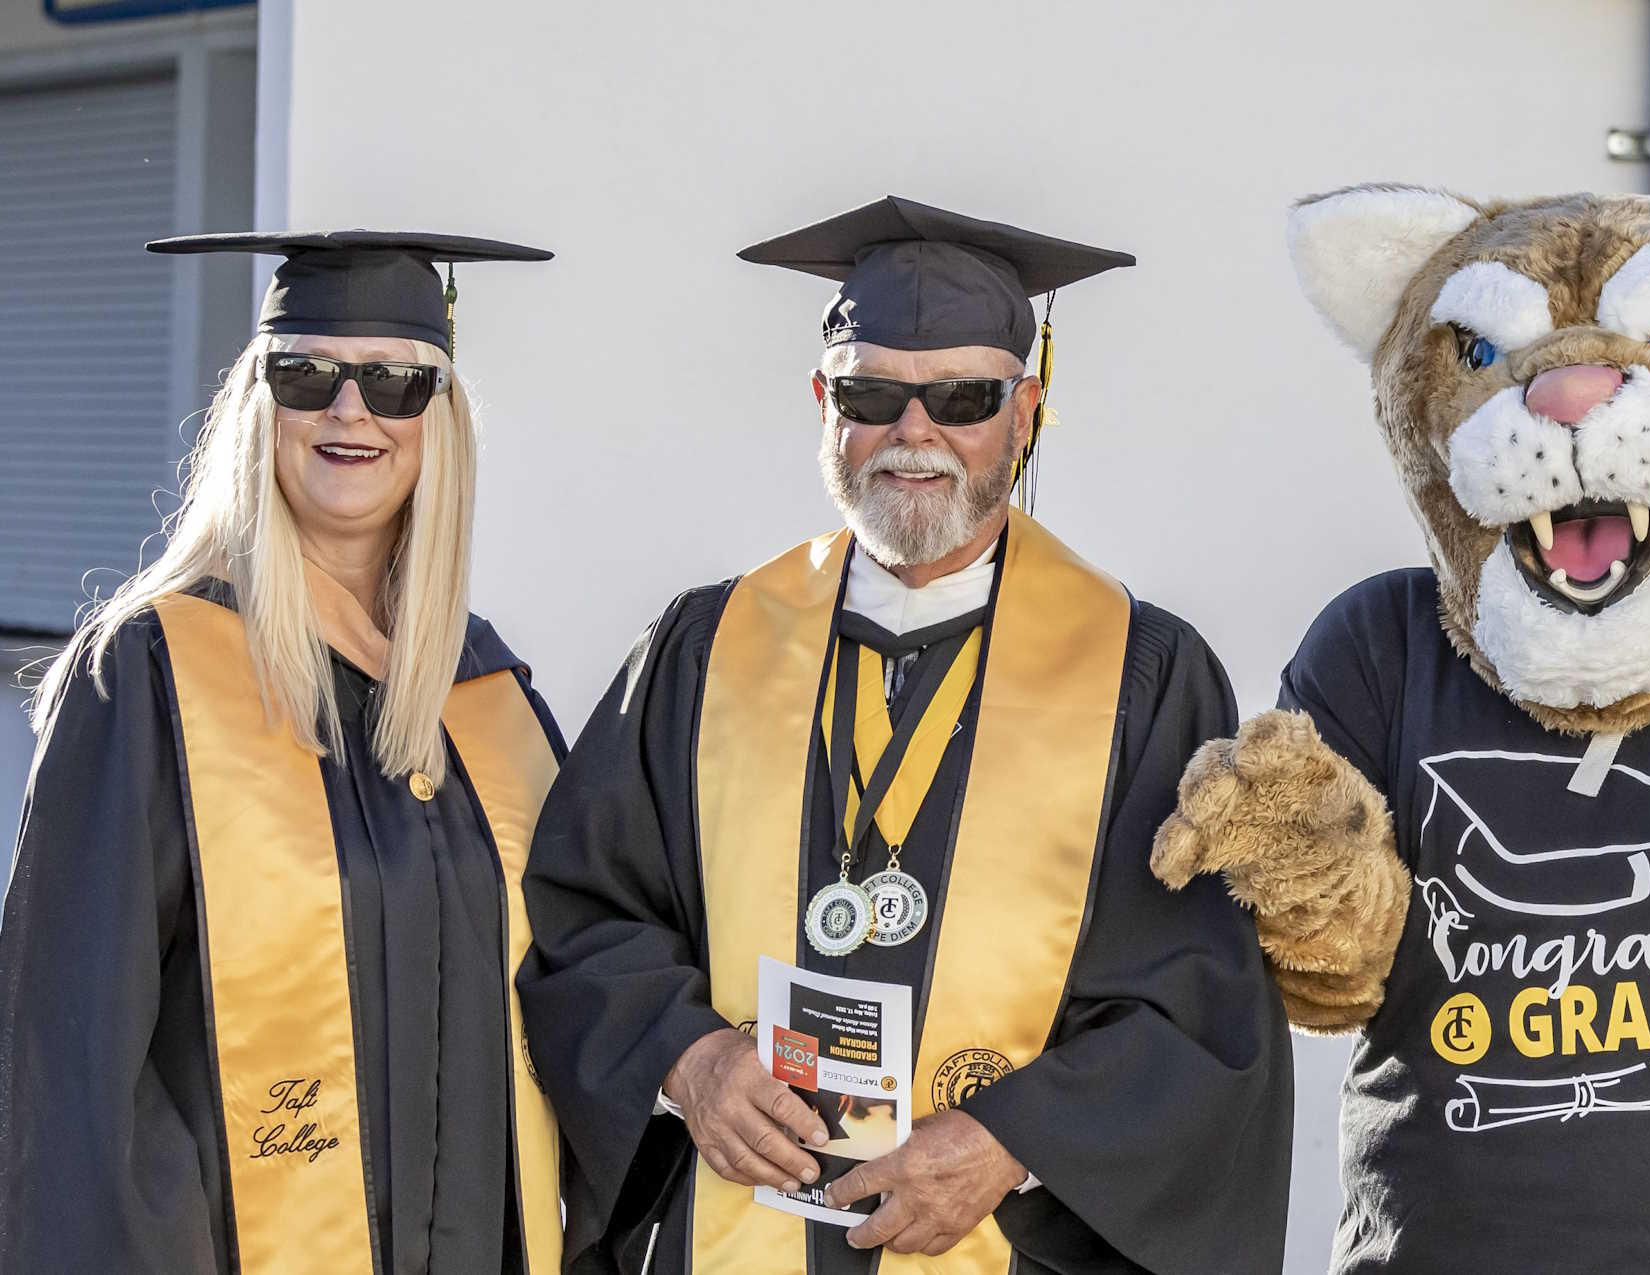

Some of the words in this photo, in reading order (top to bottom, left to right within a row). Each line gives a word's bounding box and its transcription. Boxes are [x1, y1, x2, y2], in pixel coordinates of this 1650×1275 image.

[880, 875, 923, 906] COLLEGE
[890, 921, 918, 942] DIEM
[775, 1041, 815, 1067] 2024
[830, 1045, 878, 1062] GRADUATION
[839, 1036, 878, 1050] PROGRAM
[939, 1053, 968, 1078] TAFT
[972, 1052, 1011, 1074] COLLE
[260, 1079, 321, 1119] Taft
[250, 1123, 340, 1163] College
